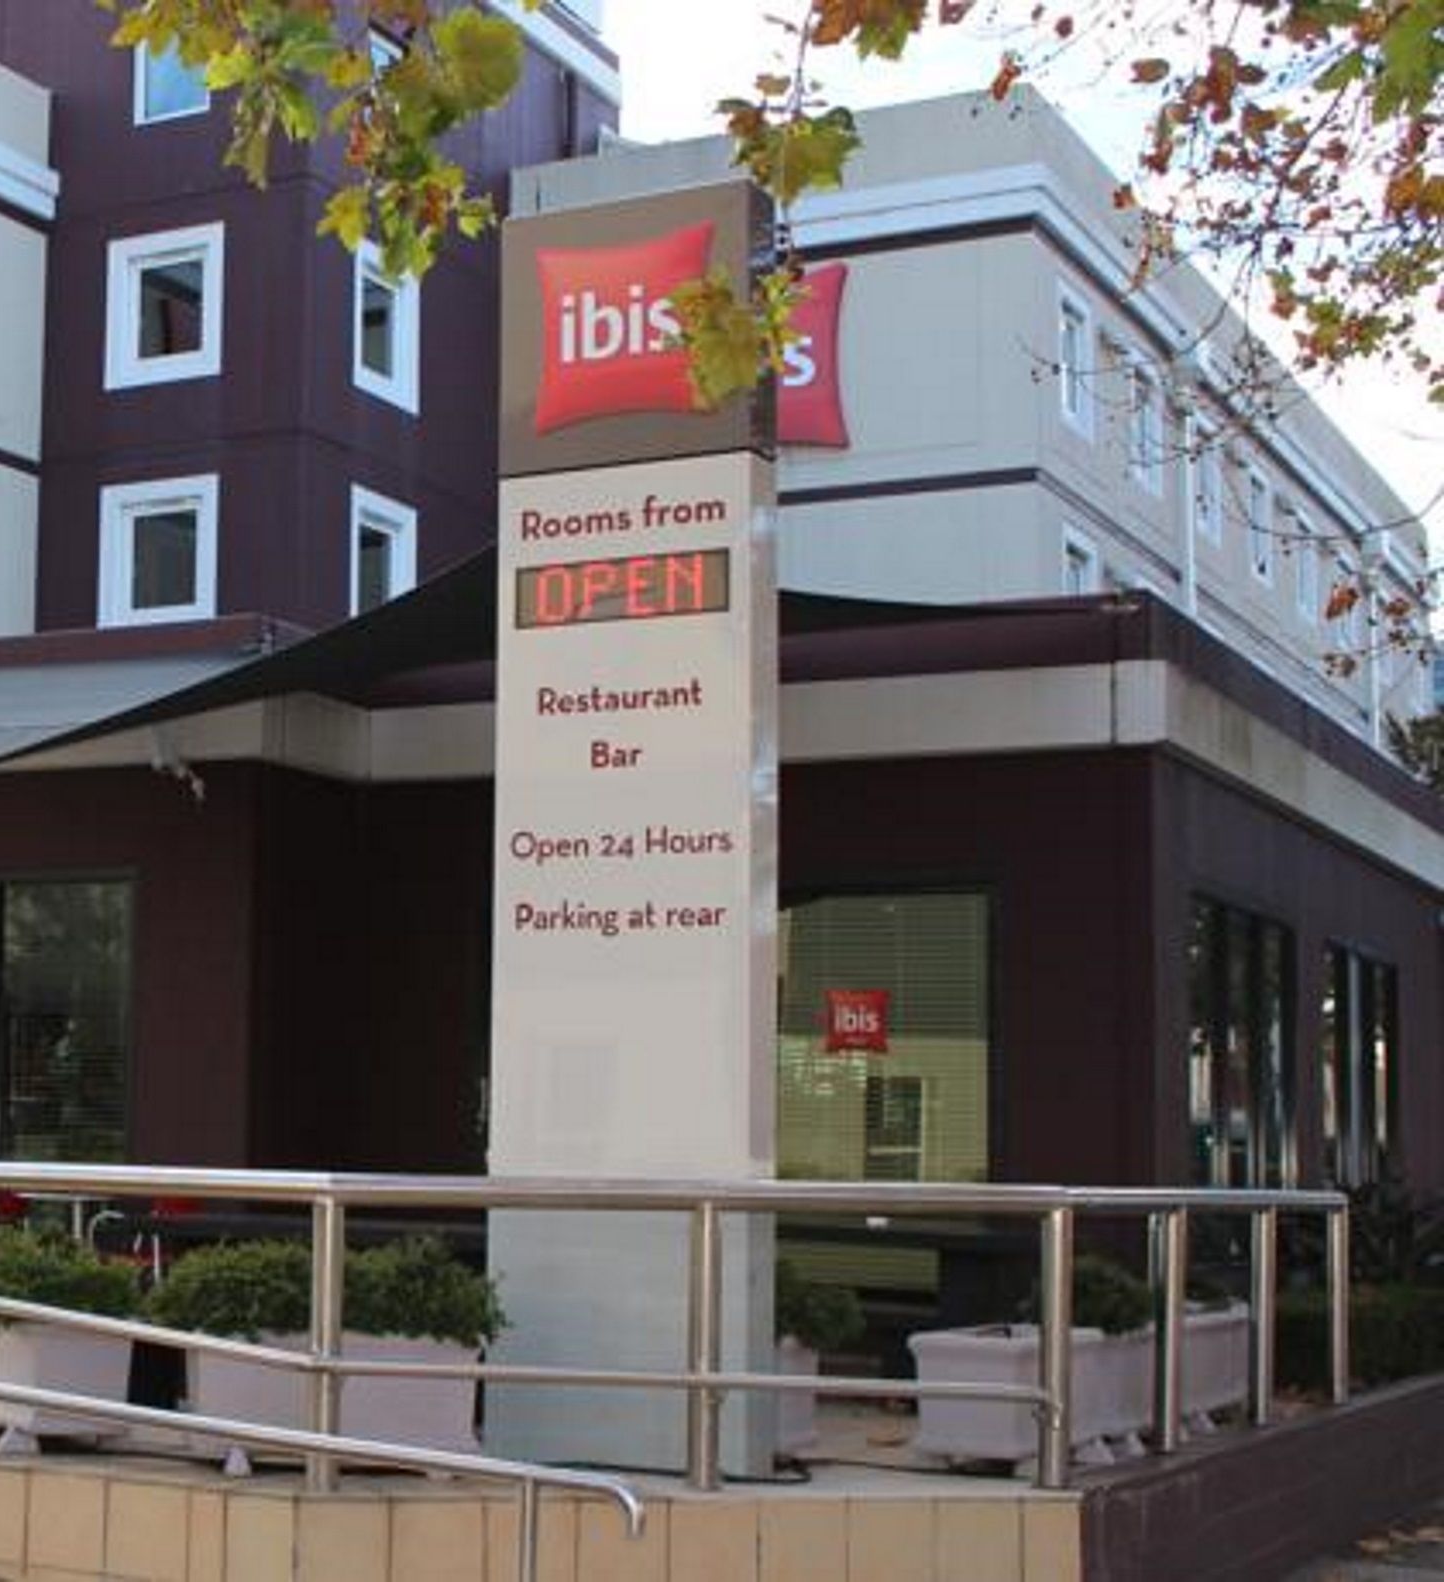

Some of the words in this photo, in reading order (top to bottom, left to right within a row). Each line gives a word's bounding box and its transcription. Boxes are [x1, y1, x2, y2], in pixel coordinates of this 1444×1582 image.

[560, 285, 683, 363] ibis
[521, 508, 632, 541] Rooms
[643, 496, 726, 528] from
[536, 554, 704, 627] OPEN
[537, 678, 703, 716] Restaurant
[590, 741, 643, 769] Bar
[510, 832, 589, 865] Open
[600, 834, 634, 860] 24
[645, 826, 733, 856] Hours
[514, 901, 620, 937] Parking
[628, 902, 656, 928] at
[666, 907, 727, 928] rear
[834, 1003, 879, 1034] ibis
